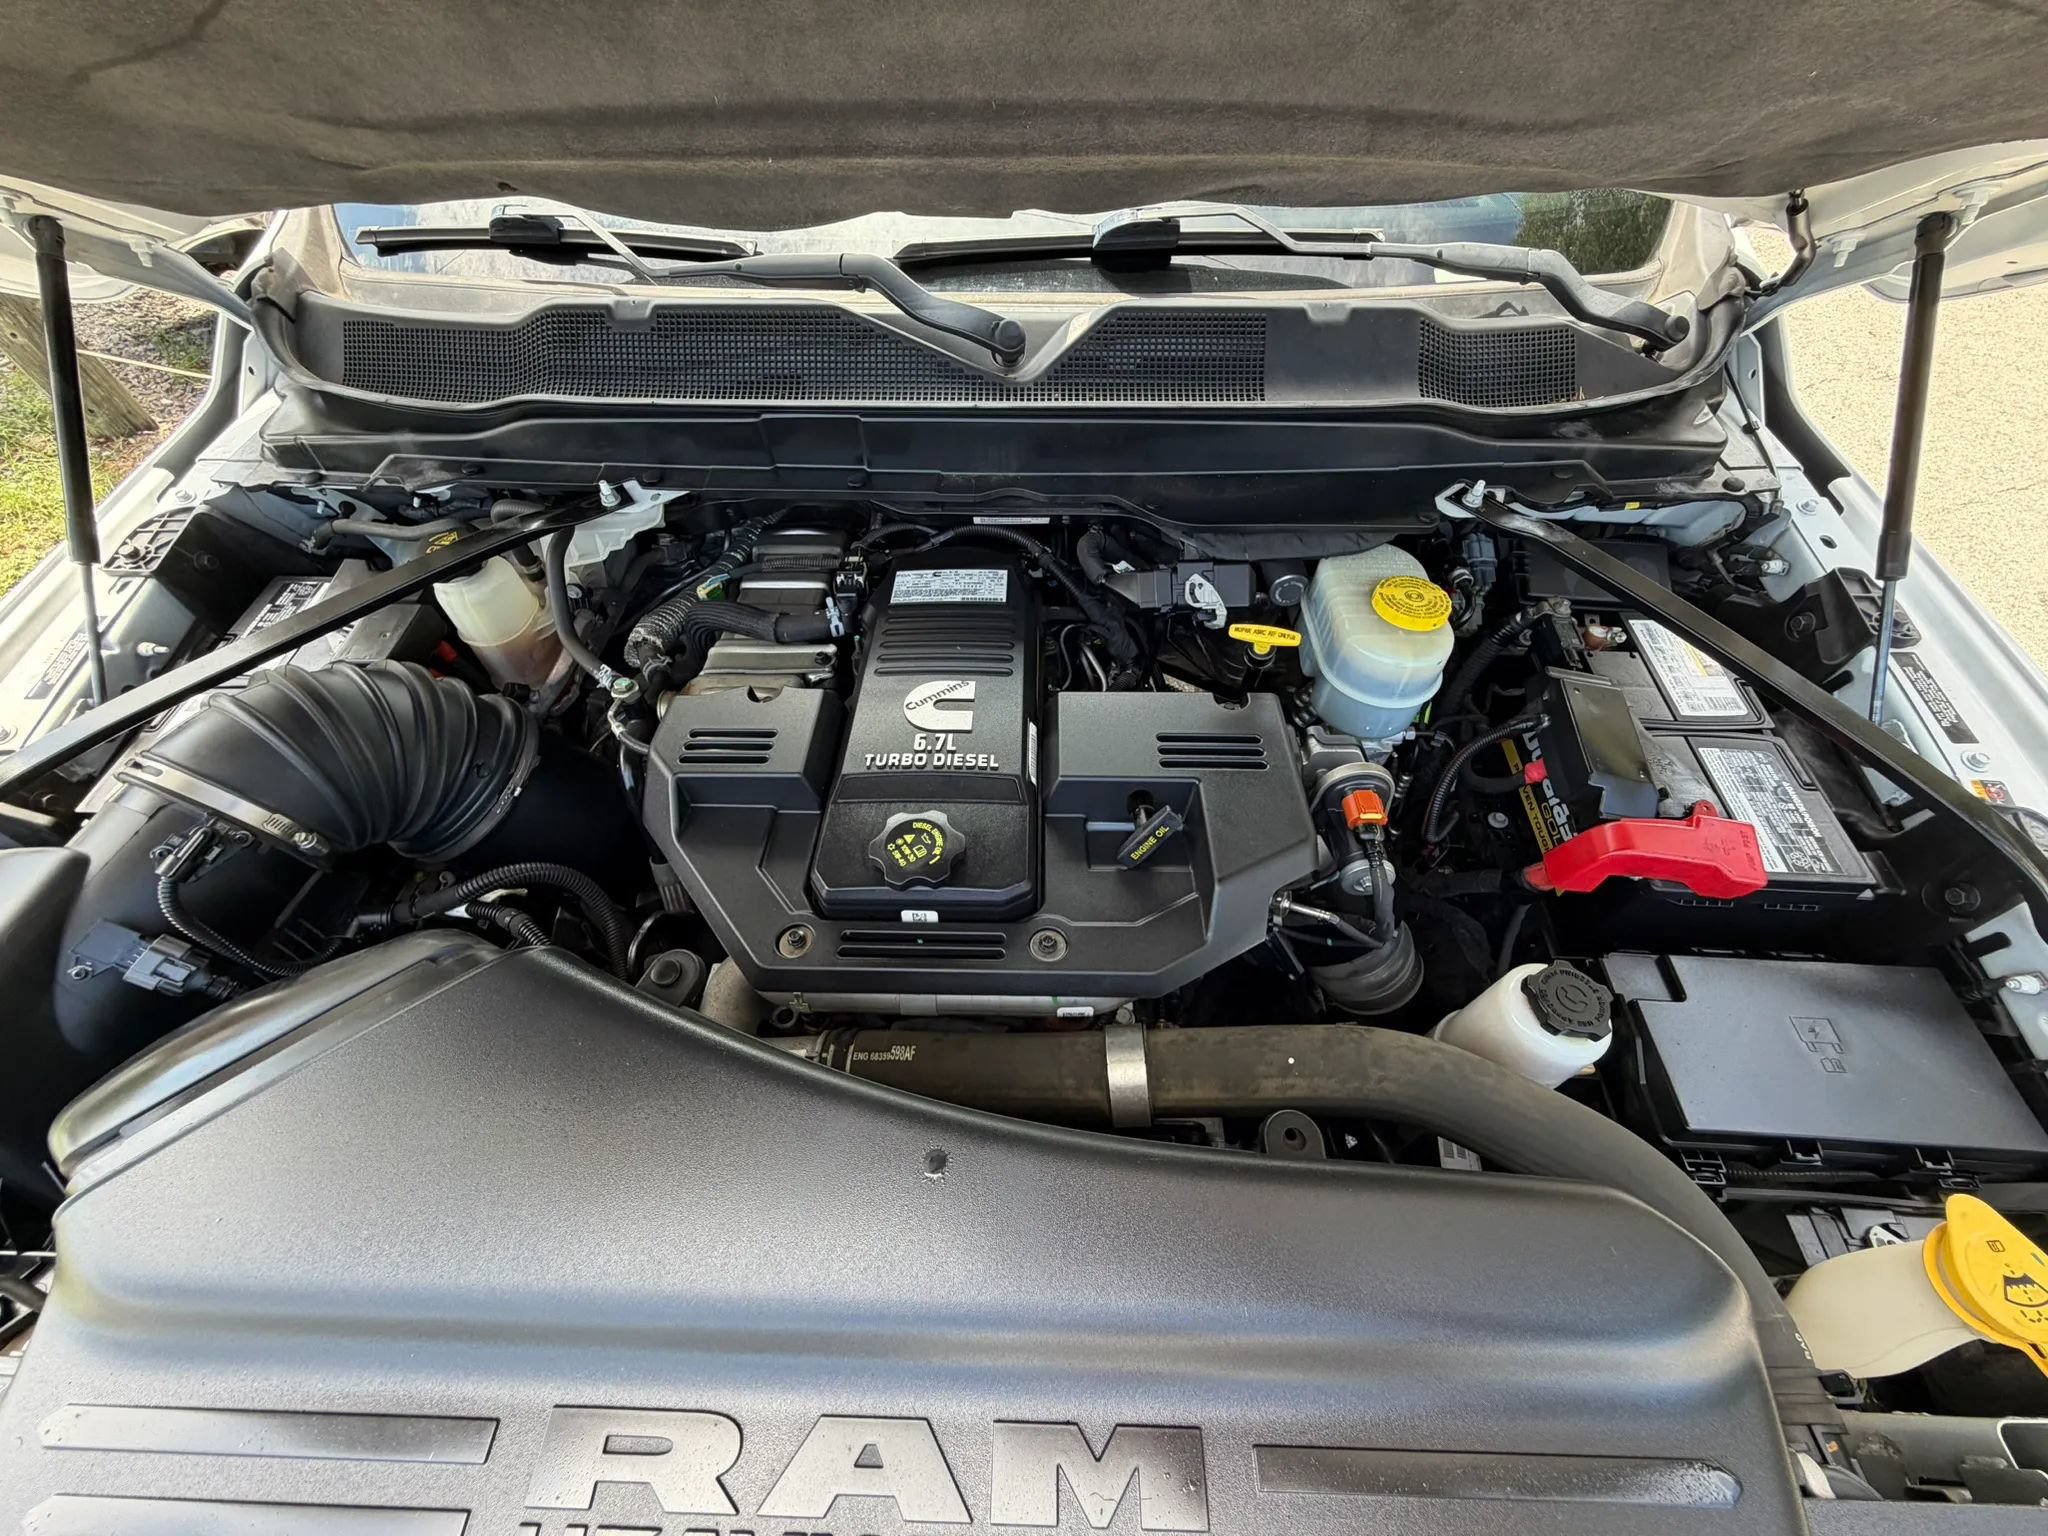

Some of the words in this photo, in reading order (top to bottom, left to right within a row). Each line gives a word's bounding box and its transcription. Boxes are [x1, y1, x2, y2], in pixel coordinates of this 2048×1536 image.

[905, 680, 970, 711] Cummins
[913, 733, 957, 752] 6.7L
[865, 753, 928, 768] TURBO
[933, 753, 999, 769] DIESEL
[912, 821, 934, 832] DIESEL
[930, 827, 944, 847] ENGINE
[1130, 835, 1157, 861] ENGINE
[1155, 825, 1170, 838] OIL
[853, 1051, 869, 1061] ENG
[525, 1405, 1210, 1532] RAM
